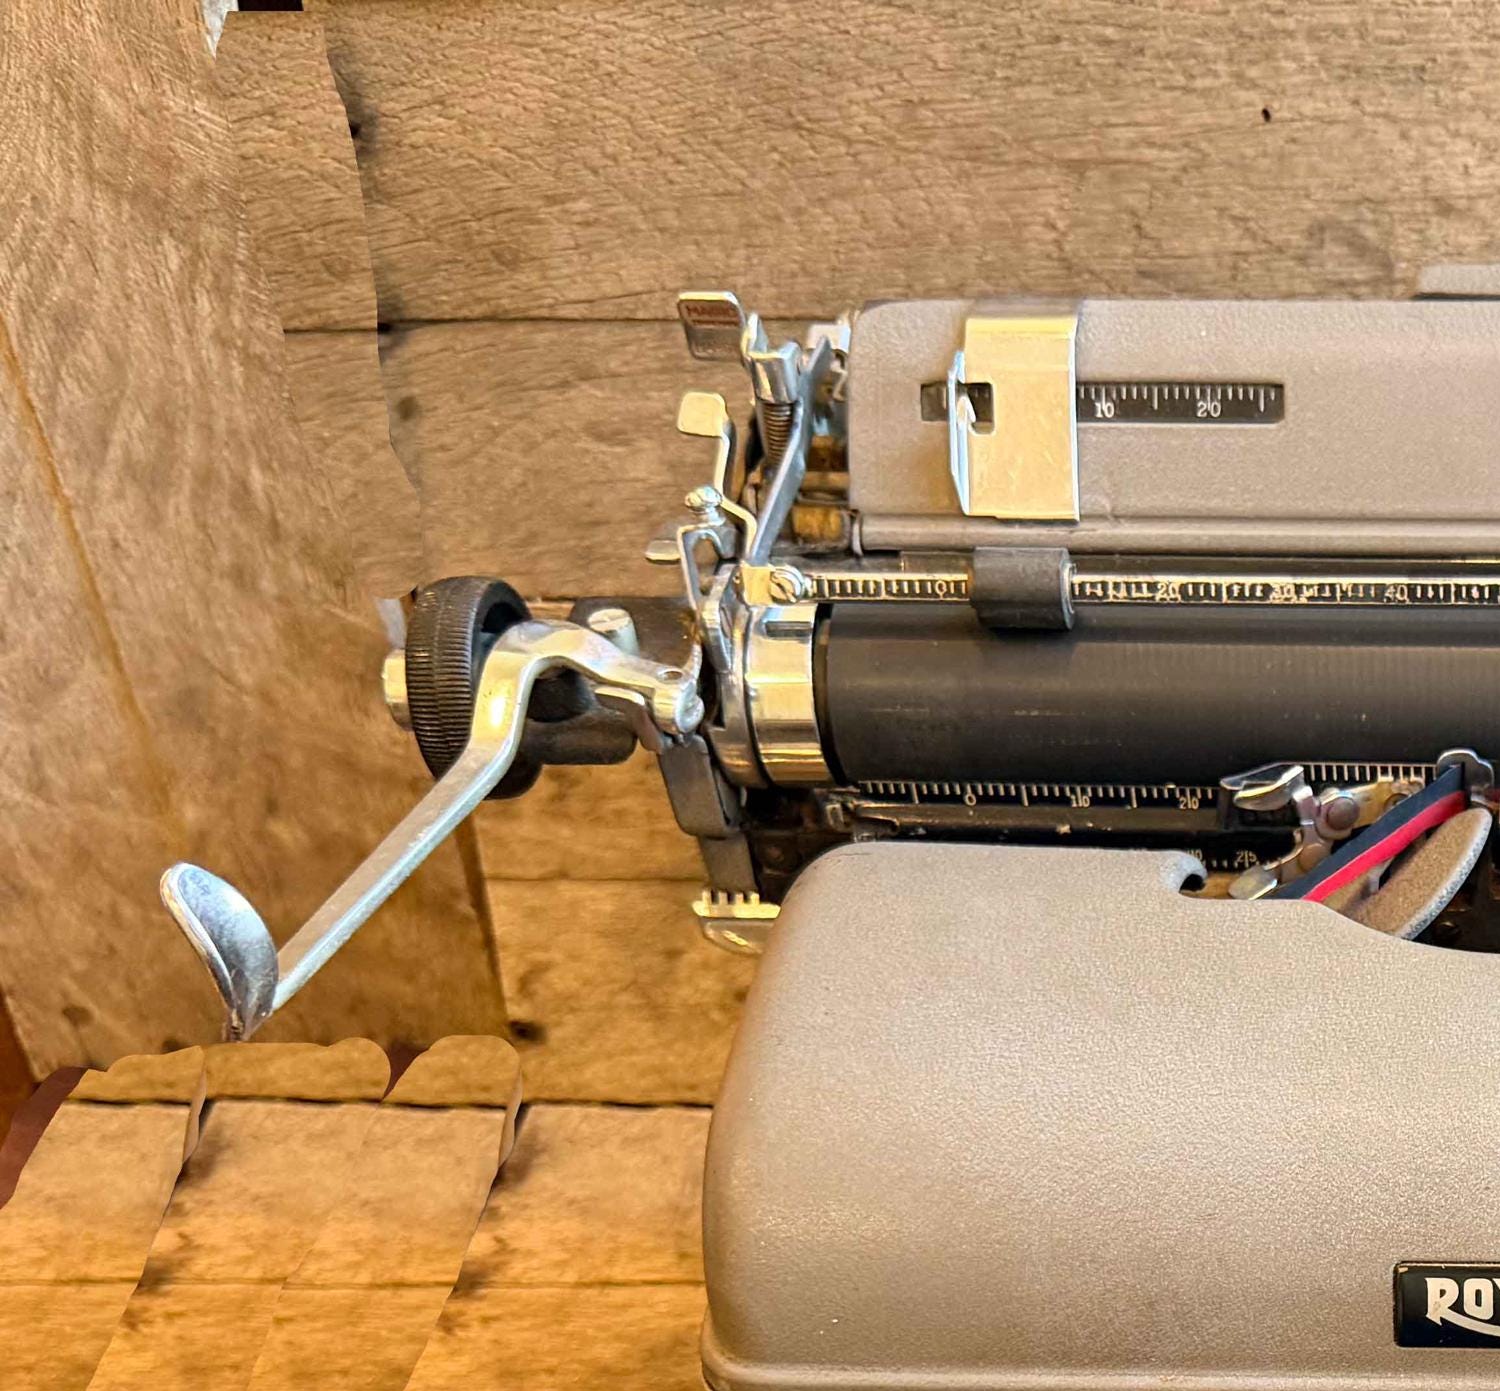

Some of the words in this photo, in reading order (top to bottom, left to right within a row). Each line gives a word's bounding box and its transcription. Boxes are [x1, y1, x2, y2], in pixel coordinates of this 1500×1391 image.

[1094, 402, 1115, 418] 10
[1197, 402, 1222, 418] 20
[1071, 796, 1090, 808] 10
[1180, 796, 1200, 809] 20
